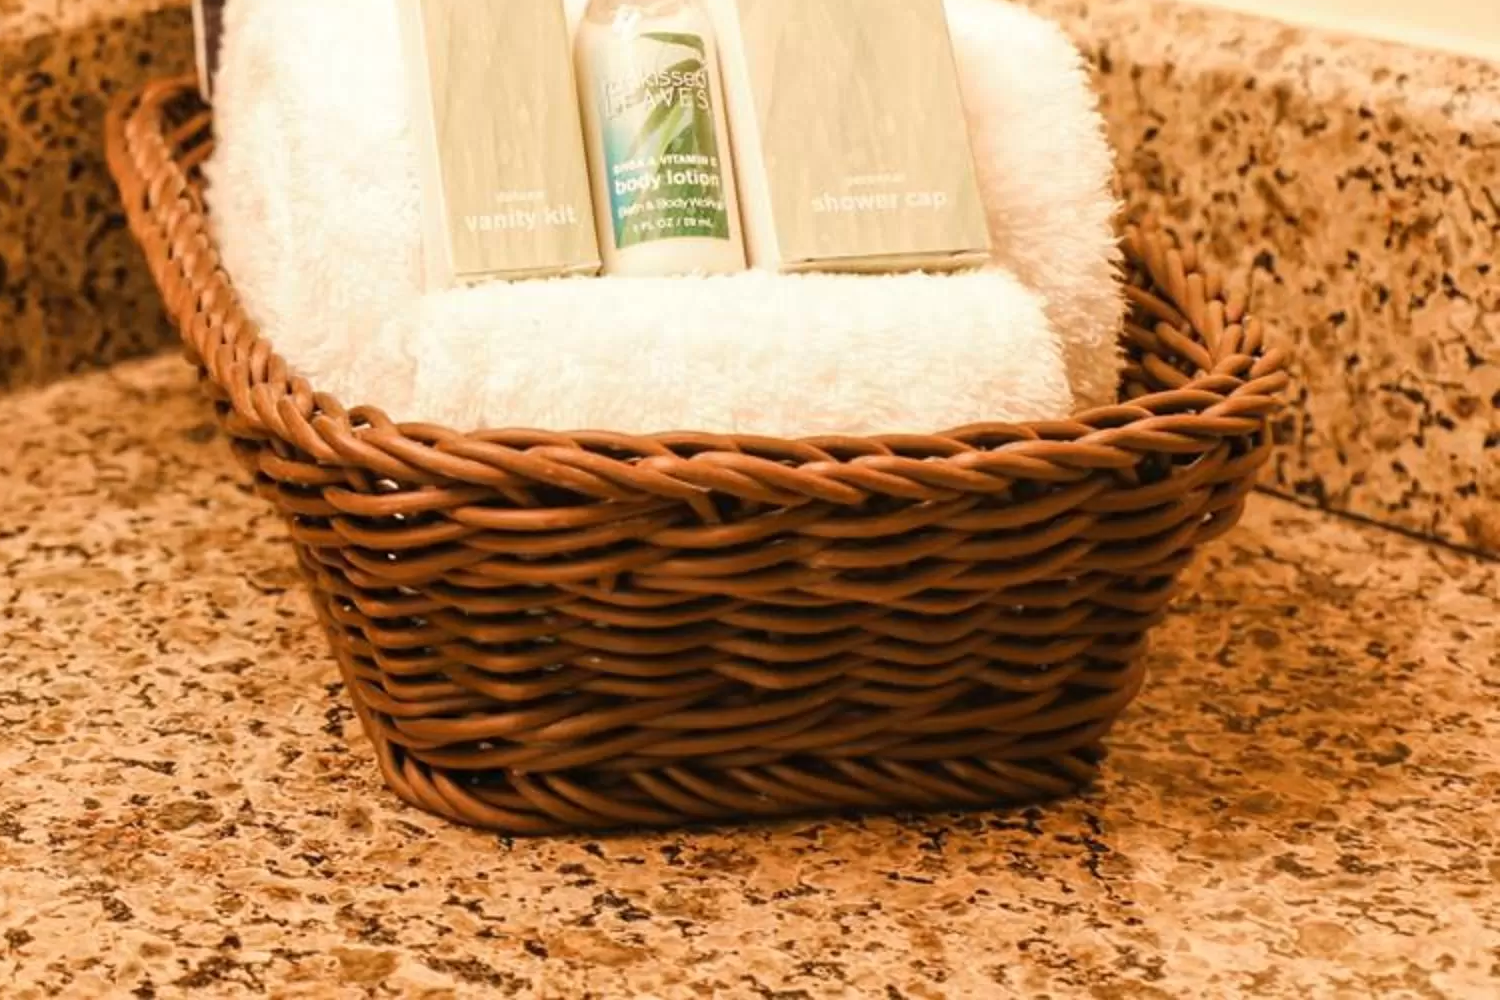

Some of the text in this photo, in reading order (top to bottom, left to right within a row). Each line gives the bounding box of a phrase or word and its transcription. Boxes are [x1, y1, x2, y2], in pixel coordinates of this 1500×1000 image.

[614, 168, 720, 196] body lotion
[810, 190, 949, 216] shower cap
[462, 203, 580, 233] vanity kit
